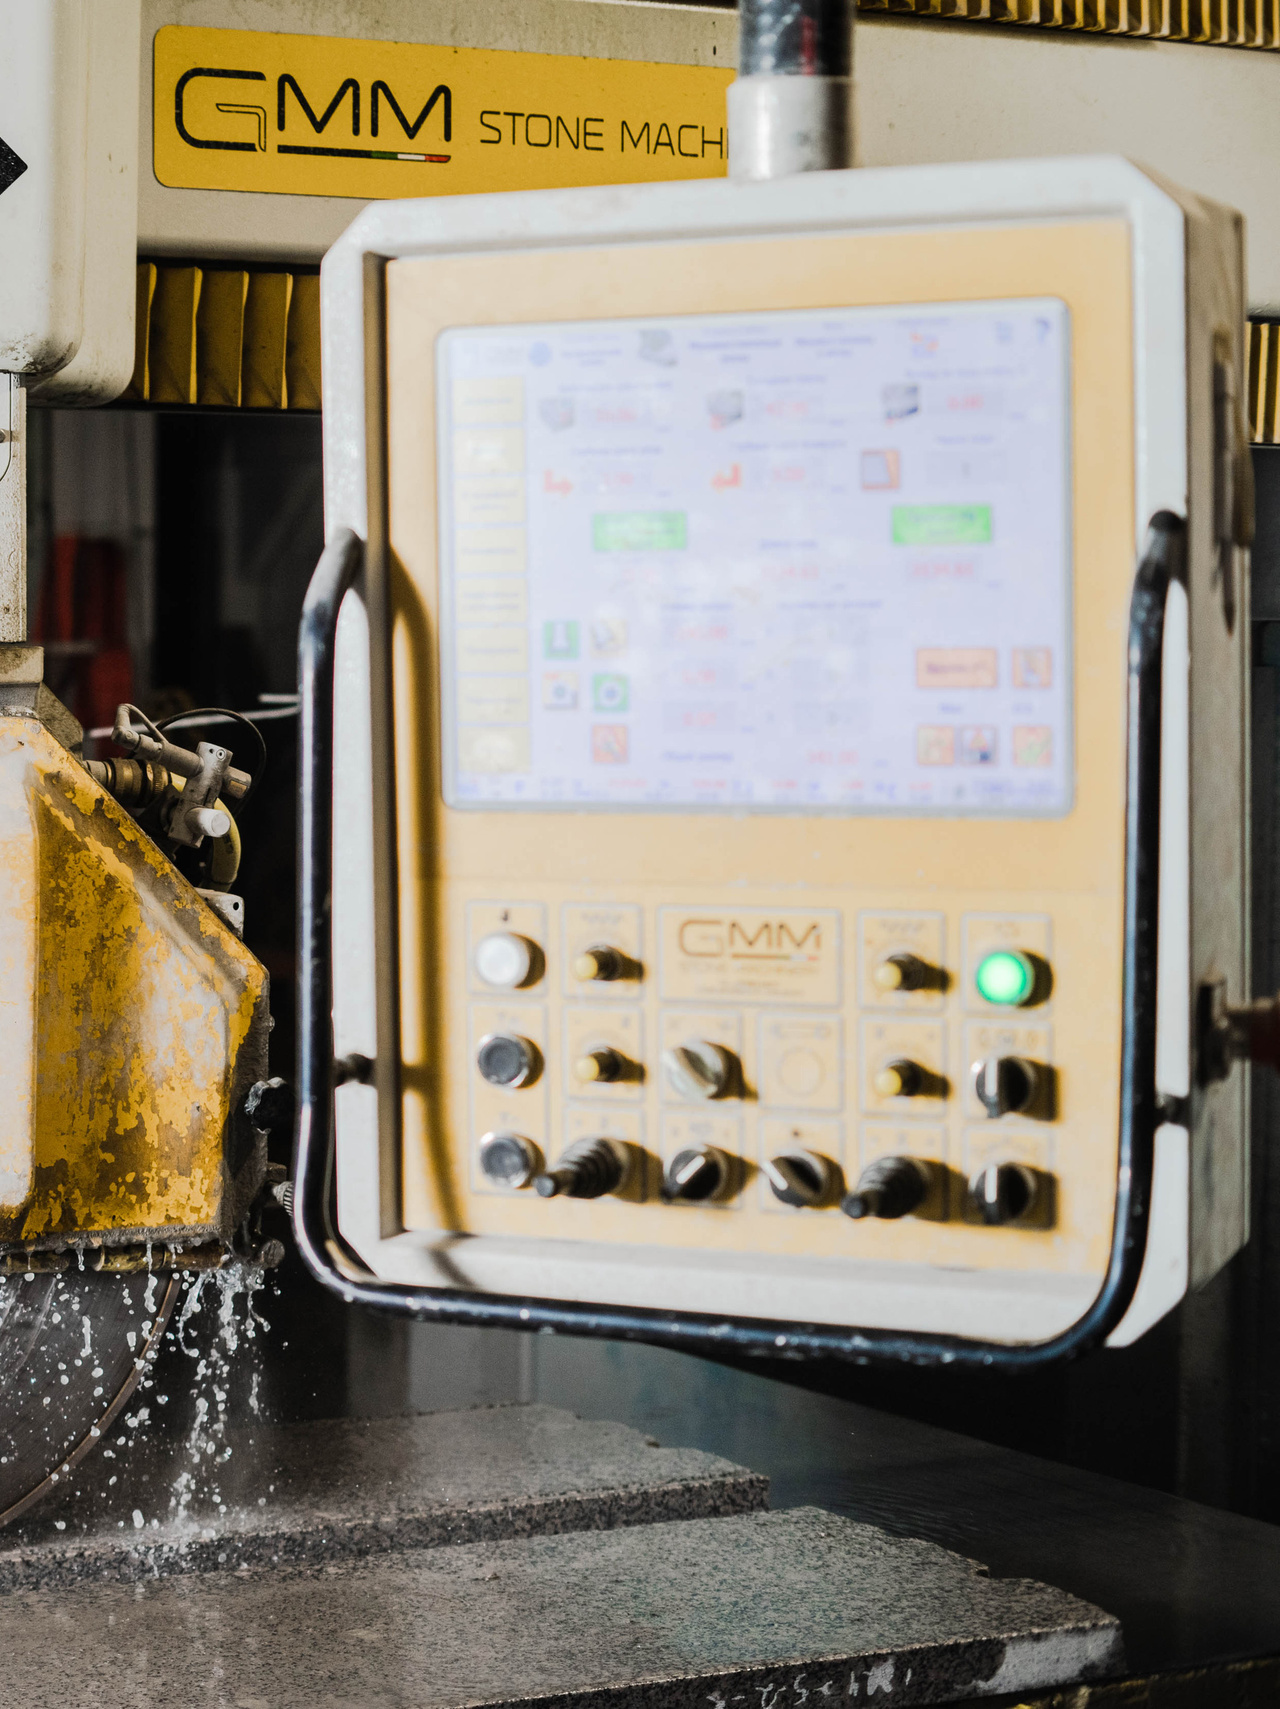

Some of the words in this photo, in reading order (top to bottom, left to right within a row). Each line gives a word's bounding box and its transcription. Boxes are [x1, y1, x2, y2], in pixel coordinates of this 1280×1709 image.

[175, 67, 453, 153] GMM
[480, 110, 604, 151] STONE
[679, 919, 822, 957] GMM
